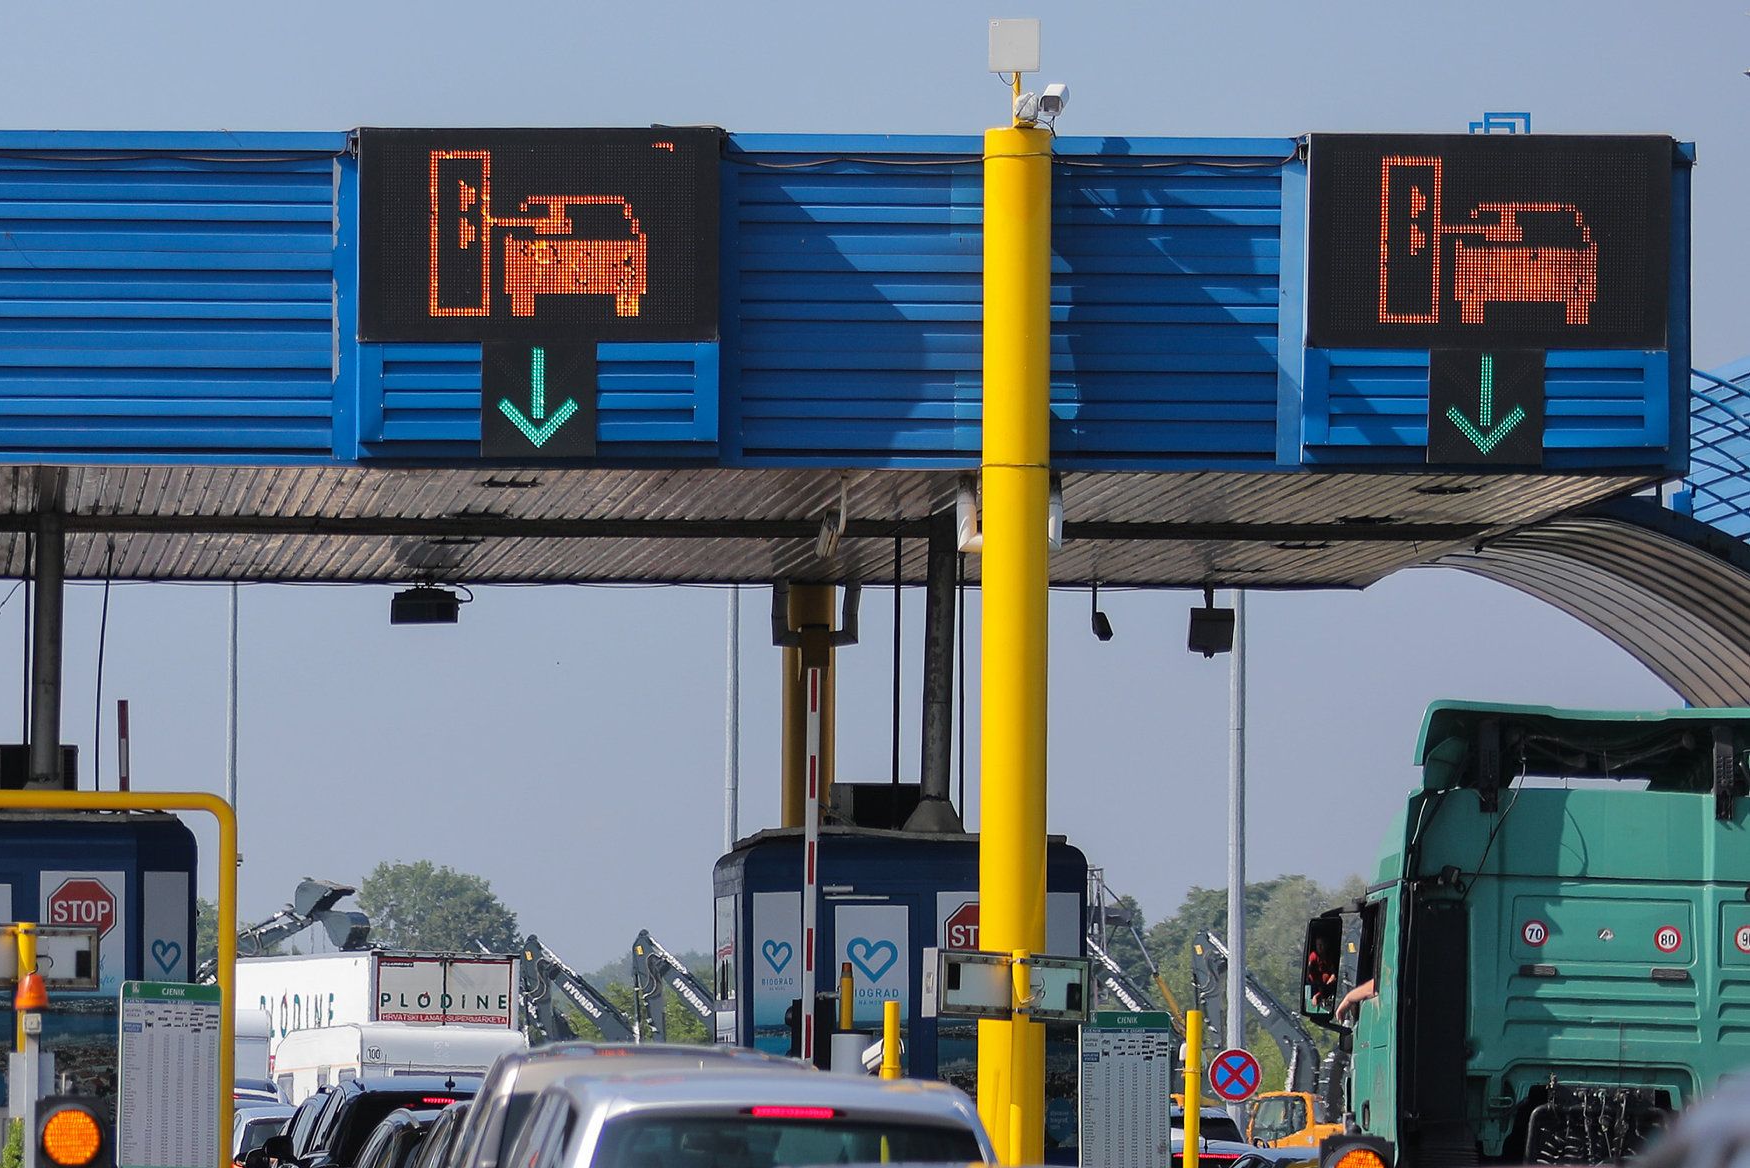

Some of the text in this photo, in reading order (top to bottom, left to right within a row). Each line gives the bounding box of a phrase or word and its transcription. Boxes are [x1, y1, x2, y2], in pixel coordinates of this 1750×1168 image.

[53, 901, 111, 923] STOP
[951, 924, 979, 947] ST
[1528, 928, 1543, 940] 70
[1660, 934, 1676, 946] 80
[761, 977, 794, 986] BIOGRAD
[161, 987, 186, 996] CJENIK
[672, 977, 712, 1018] HYUNDAI
[854, 988, 900, 998] IOGRAD
[1105, 977, 1143, 1012] HYUNDA
[380, 992, 507, 1009] PLODINE
[562, 981, 603, 1019] HYUNDAI
[1116, 1016, 1139, 1024] CJENIK
[368, 1049, 381, 1059] 100
